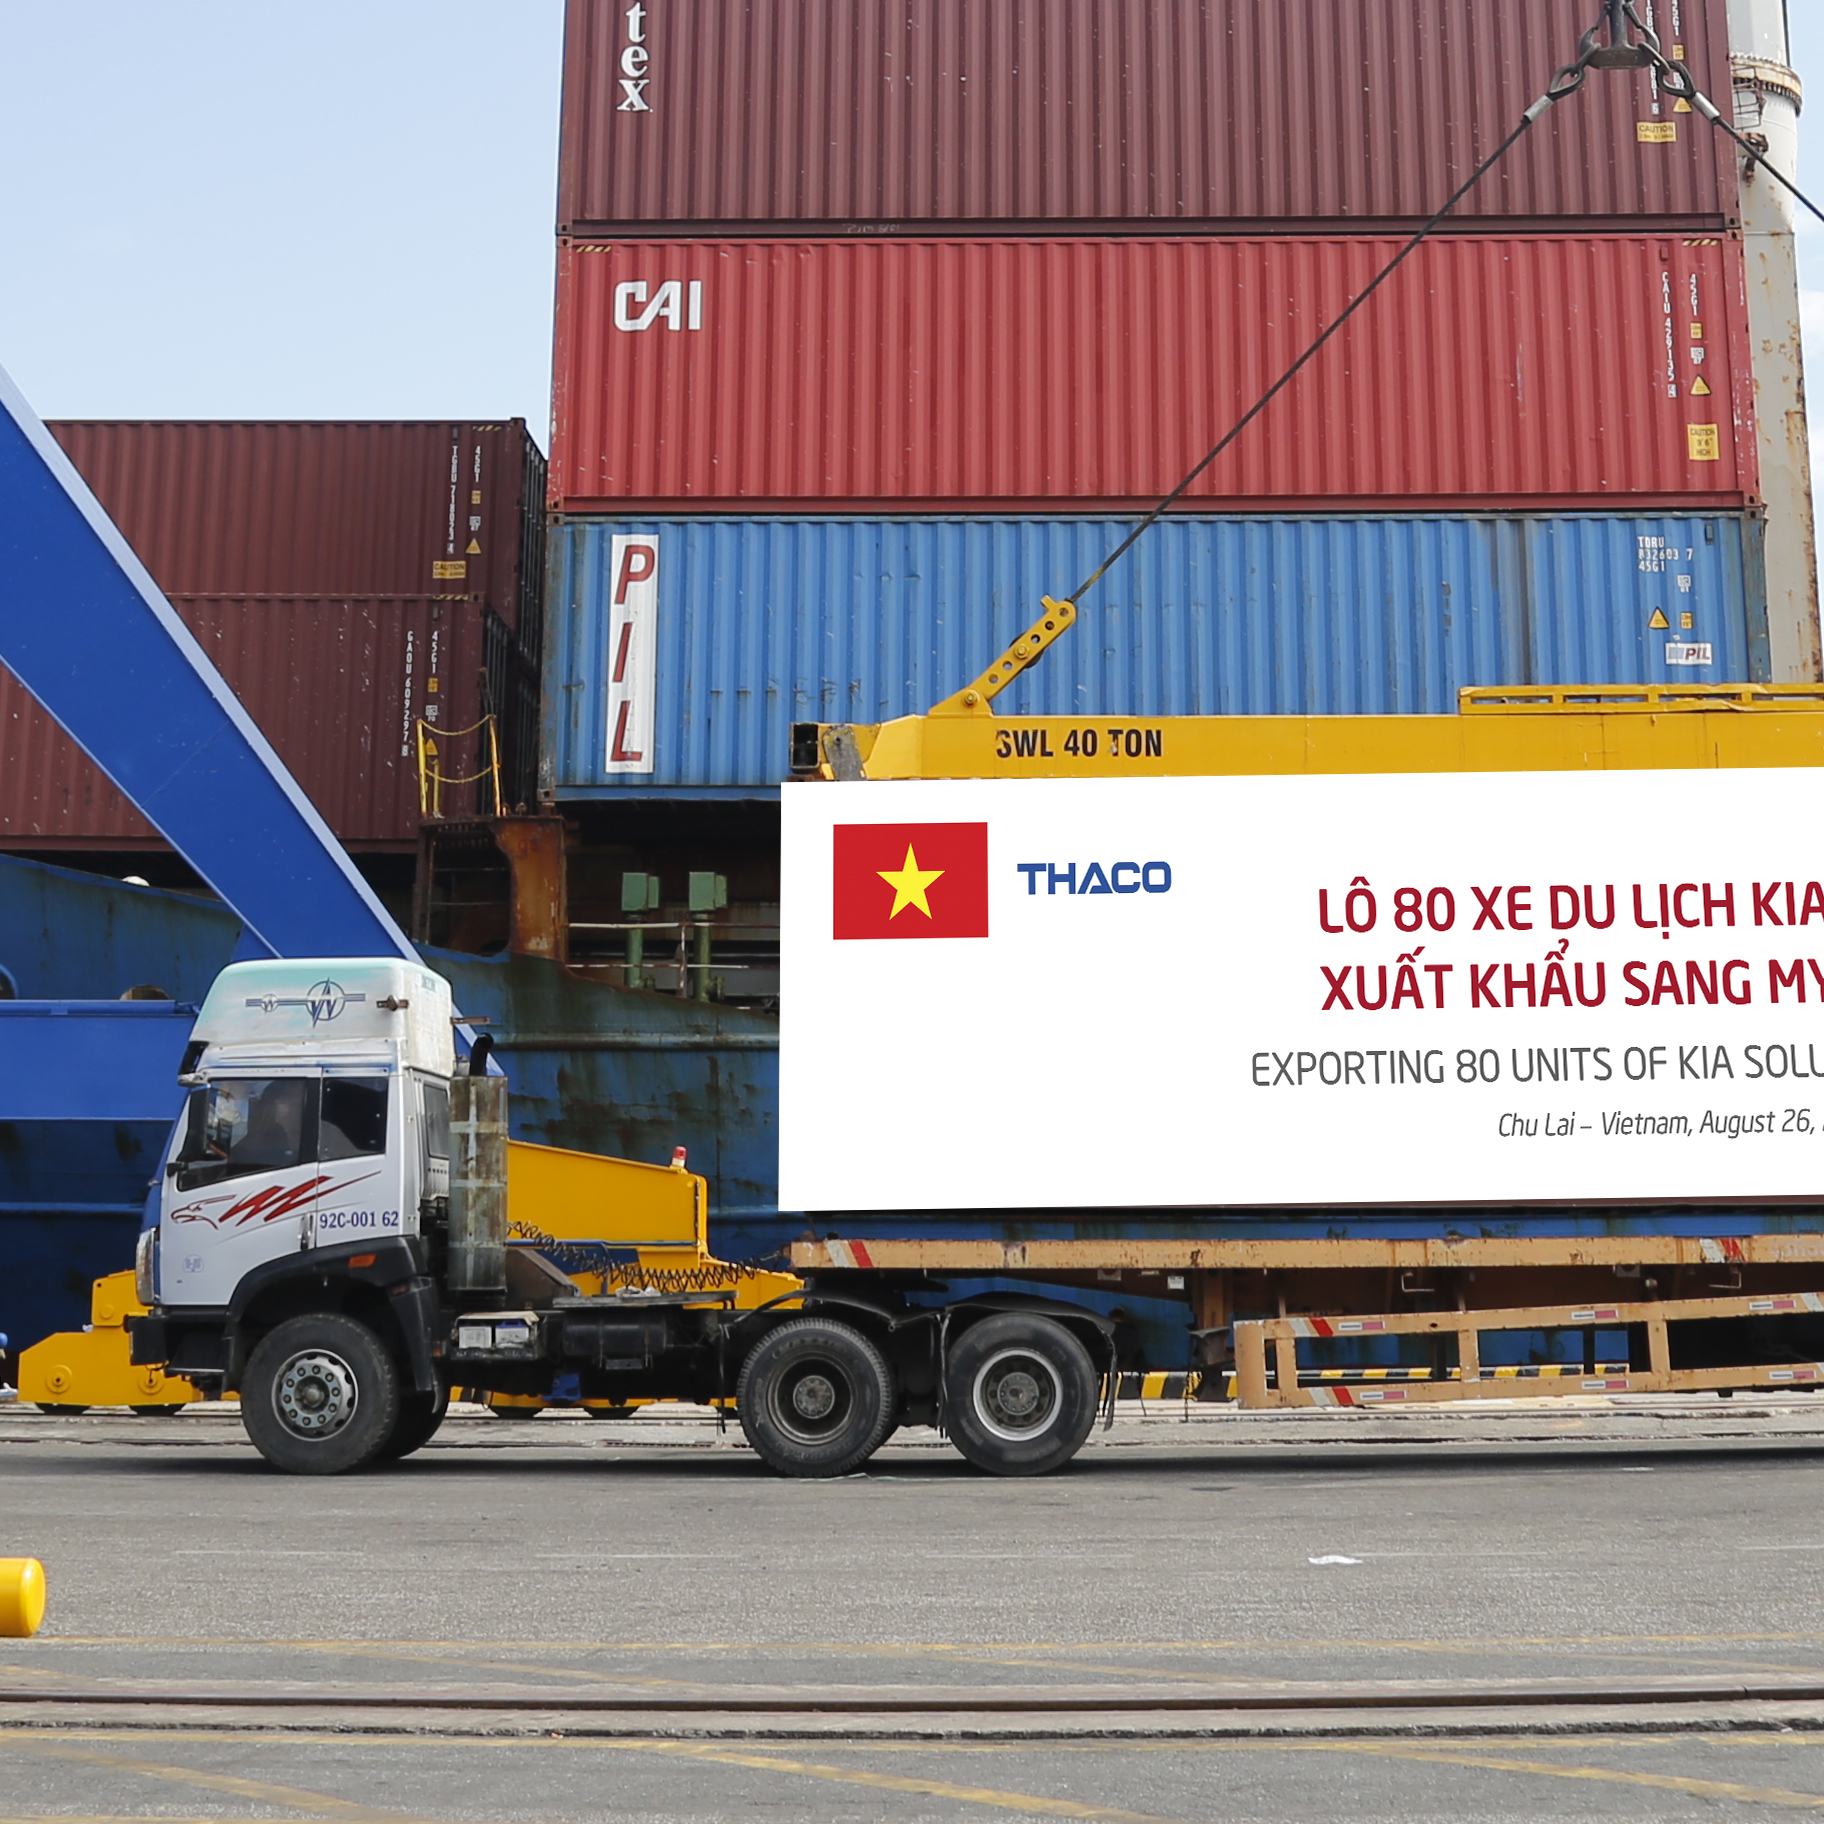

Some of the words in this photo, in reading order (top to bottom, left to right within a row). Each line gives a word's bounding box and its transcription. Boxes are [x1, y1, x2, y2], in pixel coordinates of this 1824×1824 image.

[616, 1, 650, 112] tex
[1639, 124, 1674, 133] CAUTION
[614, 280, 703, 331] CAI
[1662, 271, 1671, 314] CAIU
[1689, 273, 1698, 316] 45G1
[1638, 560, 1665, 572] 45G1
[430, 630, 439, 674] 45G1
[610, 544, 655, 763] PIL
[1685, 647, 1710, 660] PIL
[402, 677, 412, 742] 609297
[996, 730, 1054, 758] SWL
[1064, 730, 1098, 756] 40
[1108, 728, 1163, 757] TON
[1017, 861, 1171, 895] THACO
[1319, 876, 1376, 933] LÔ
[1394, 887, 1455, 932] 80
[1470, 886, 1533, 930] XE
[1550, 885, 1615, 930] DU
[1632, 883, 1735, 940] LỊCH
[1320, 946, 1453, 1010] XUẤT
[1470, 938, 1606, 1008] KHẨU
[1623, 959, 1751, 1006] SANG
[1252, 1050, 1444, 1086] EXPORTING
[1457, 1049, 1499, 1083] 80
[1512, 1047, 1612, 1082] UNITS
[1624, 1046, 1667, 1080] OF
[1679, 1046, 1734, 1079] KIA
[1499, 1113, 1538, 1137] Chu
[1545, 1112, 1575, 1136] Lai
[1602, 1111, 1692, 1136] Vietnam,
[1699, 1110, 1775, 1139] August
[1782, 1109, 1814, 1134] 26,
[319, 1211, 376, 1229] 92C-001
[382, 1211, 399, 1227] 62
